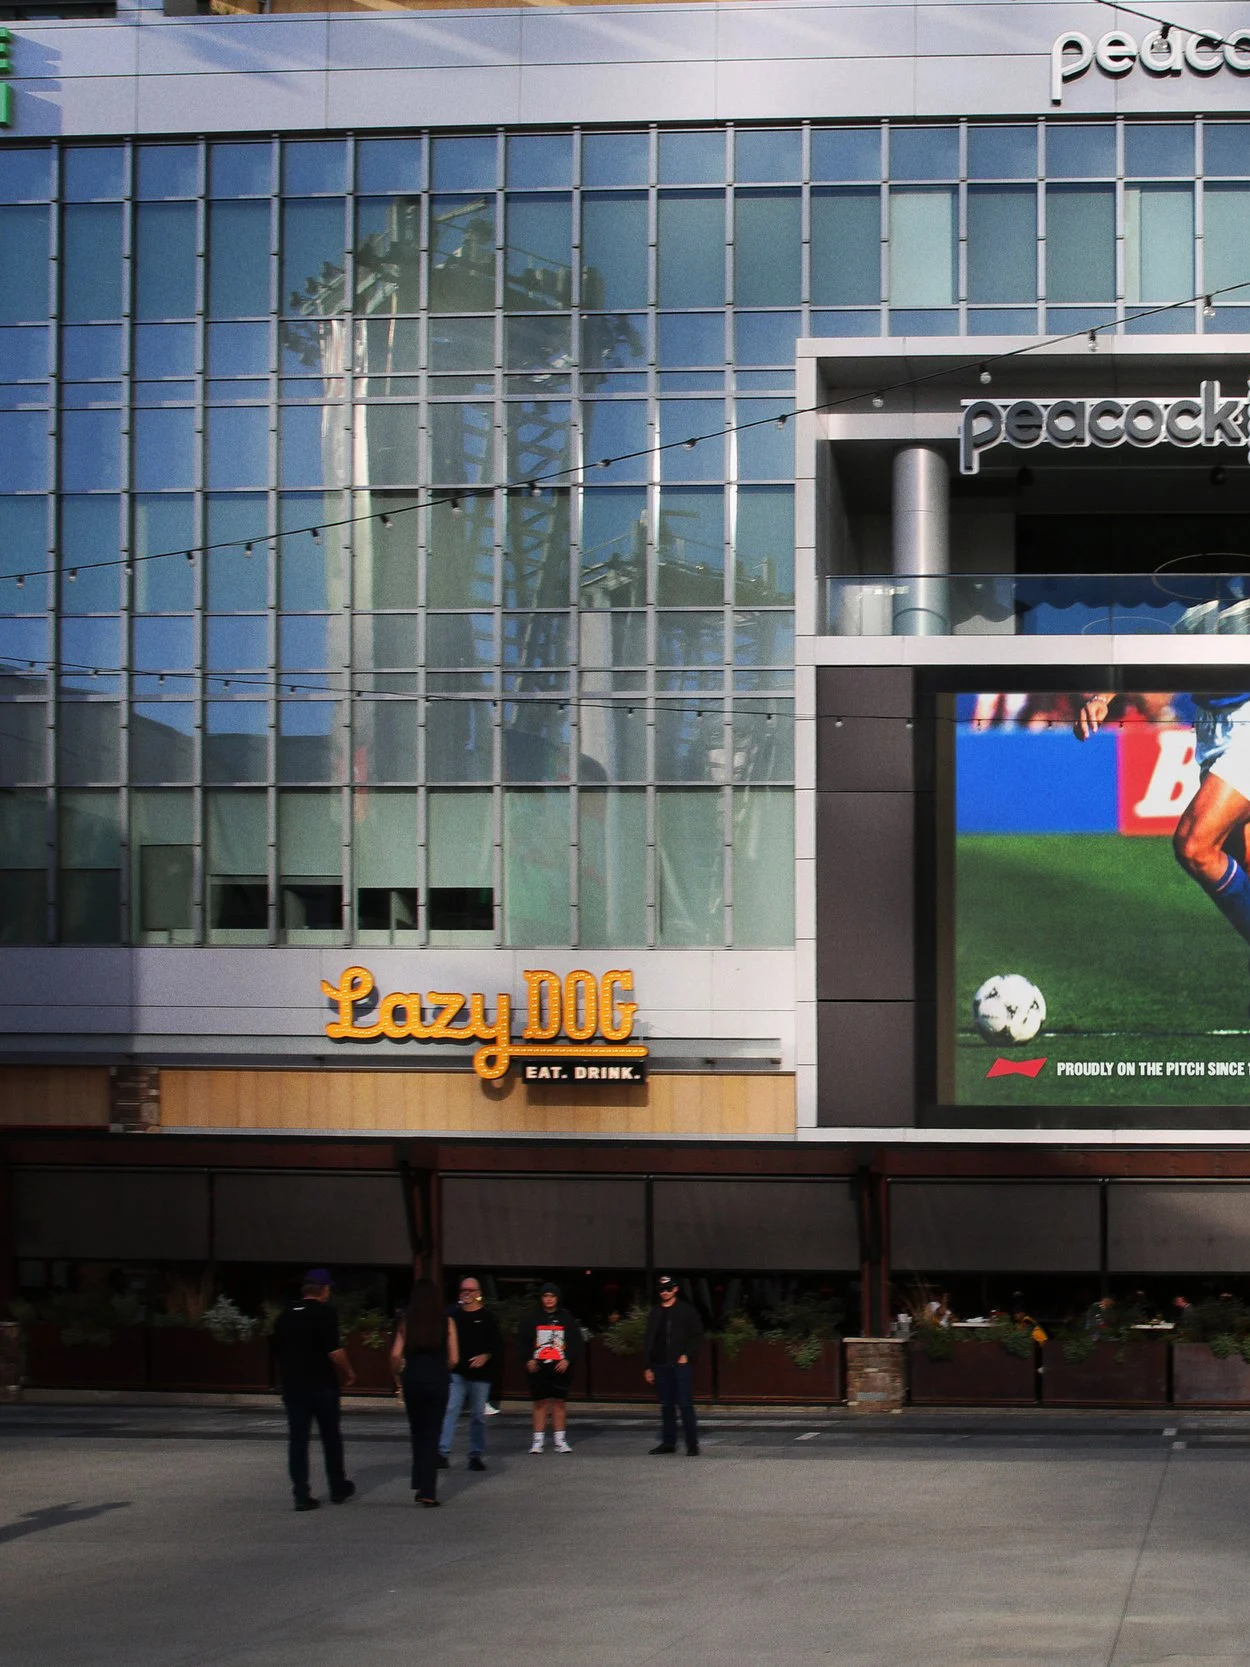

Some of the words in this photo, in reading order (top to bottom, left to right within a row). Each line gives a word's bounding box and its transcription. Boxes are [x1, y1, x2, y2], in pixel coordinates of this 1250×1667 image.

[960, 380, 1247, 474] peacock
[320, 965, 512, 1080] Lazy
[522, 969, 639, 1041] DOG
[525, 1066, 569, 1079] EAT.
[574, 1066, 641, 1079] DRINK.
[1056, 1062, 1115, 1076] PROUDLY
[1117, 1062, 1136, 1076] ON
[1139, 1062, 1163, 1076] THE
[1166, 1062, 1205, 1076] PITCH
[1207, 1062, 1245, 1076] SINCE
